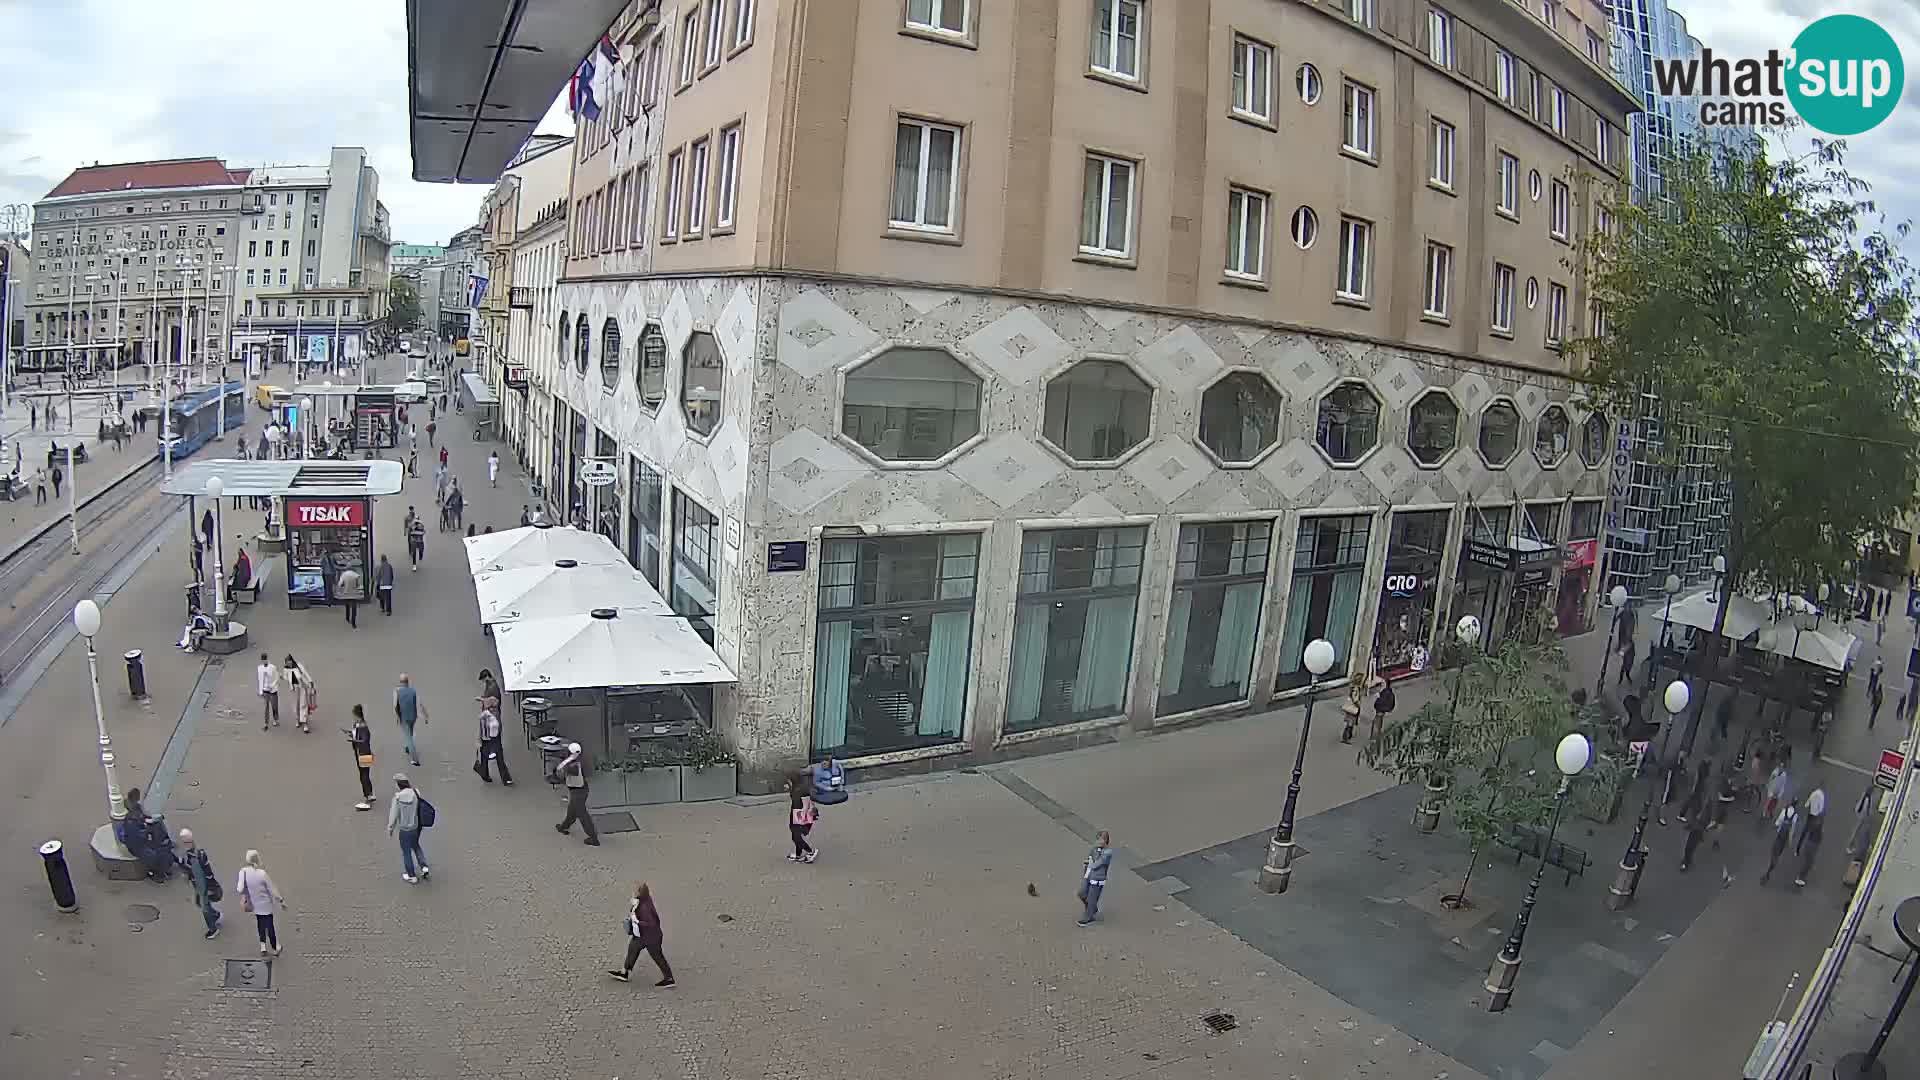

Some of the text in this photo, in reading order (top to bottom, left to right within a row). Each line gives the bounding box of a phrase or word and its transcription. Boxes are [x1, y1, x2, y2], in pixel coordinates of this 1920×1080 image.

[121, 238, 214, 252] EDIONICA
[1607, 416, 1632, 529] BROVNIK
[299, 505, 352, 523] TISAK
